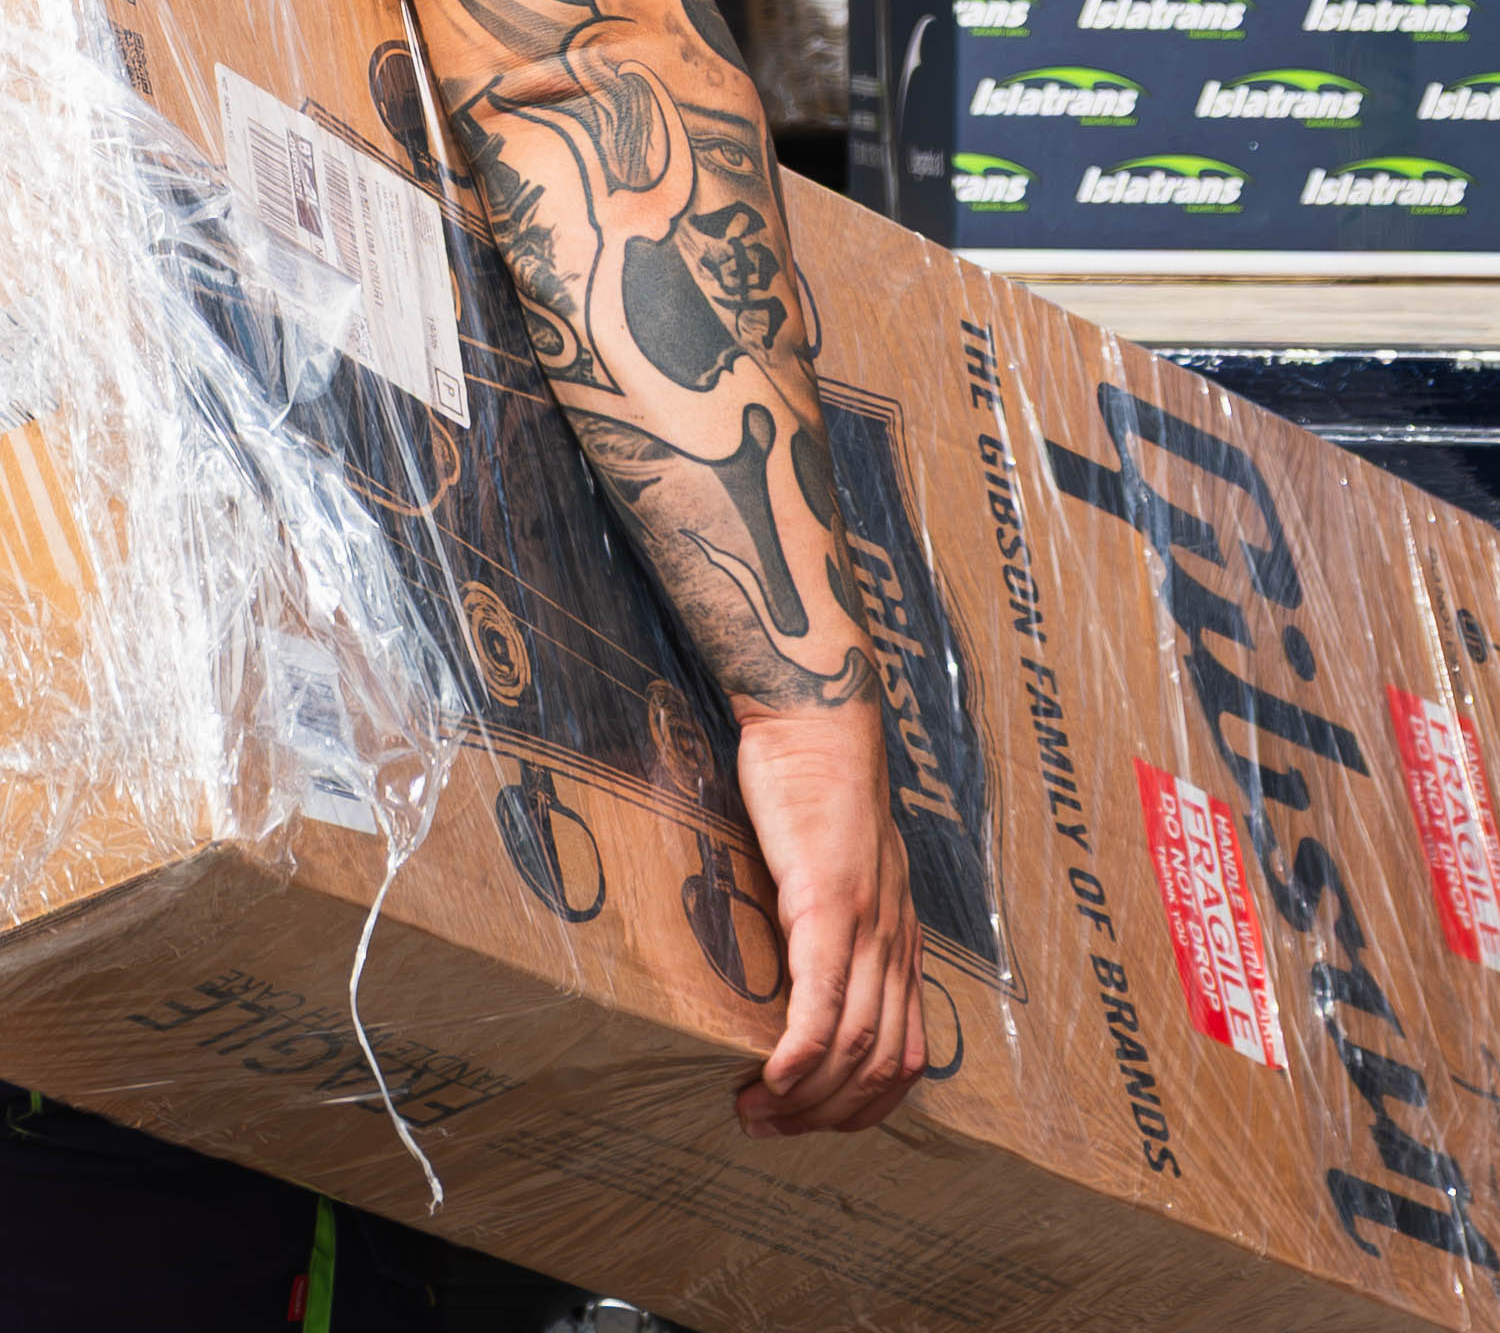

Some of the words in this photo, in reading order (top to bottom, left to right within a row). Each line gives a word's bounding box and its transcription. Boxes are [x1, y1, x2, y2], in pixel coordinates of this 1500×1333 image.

[968, 76, 1140, 119] Islatrans
[1194, 79, 1365, 121] Islatrans
[1075, 165, 1246, 206] Islatrans
[1300, 167, 1469, 208] Islatrans
[959, 318, 1004, 412] THE
[977, 433, 1048, 644] GIBSON
[1020, 654, 1093, 855] FAMILY
[1160, 790, 1181, 840] DO
[1067, 865, 1118, 944] OF
[1170, 846, 1199, 913] NOT
[1213, 813, 1247, 913] HANDLE
[1182, 796, 1260, 1048] FRAGILE
[1186, 919, 1222, 1013] DROP
[125, 981, 500, 1131] FRAGILE
[1090, 952, 1182, 1180] BRANDS
